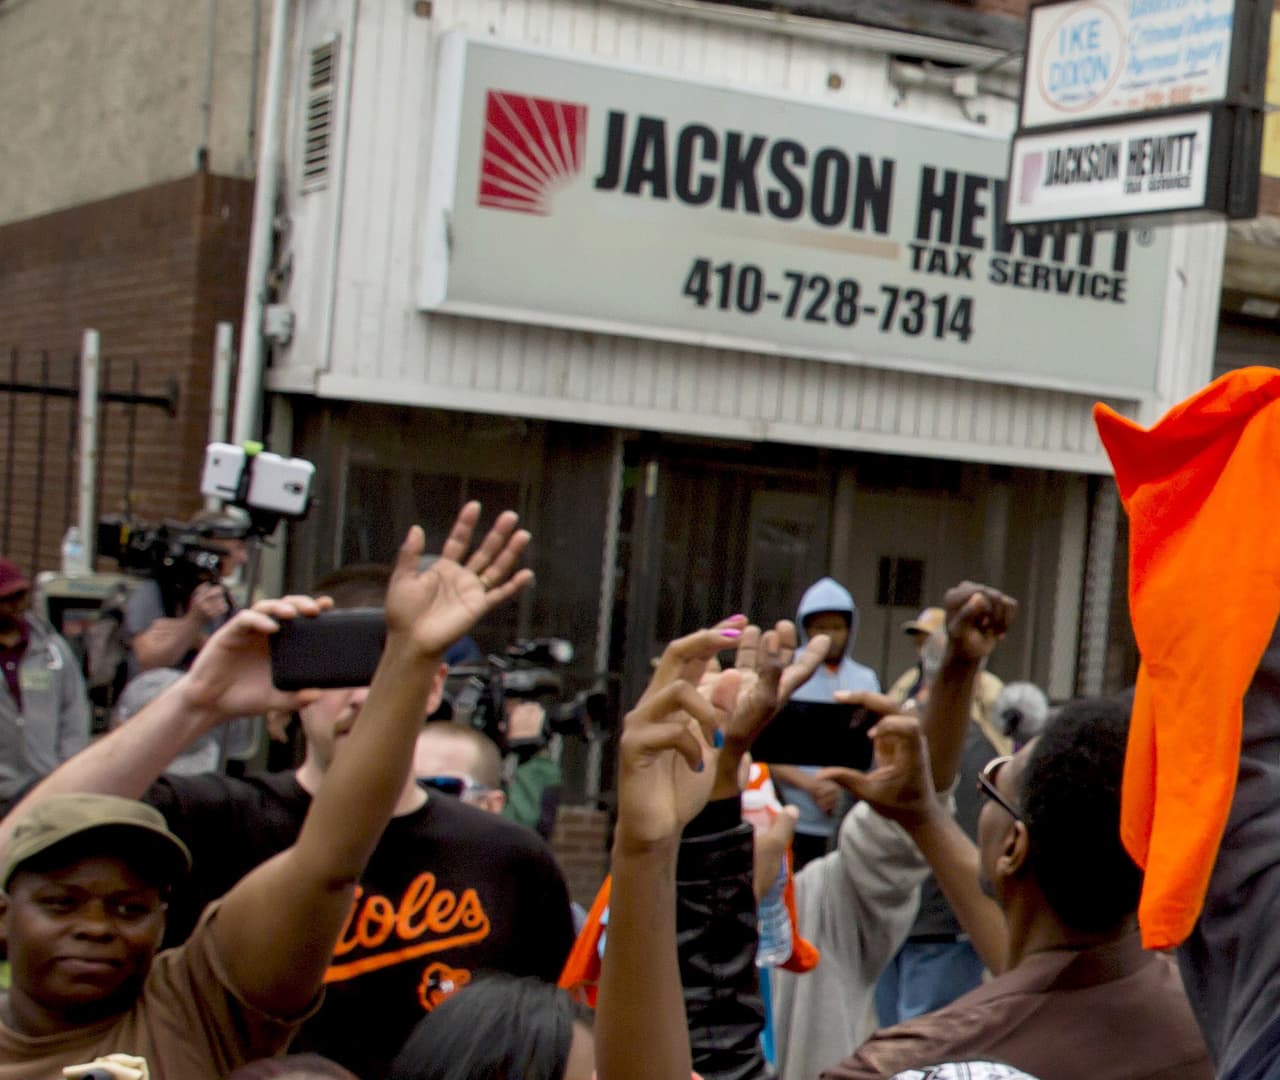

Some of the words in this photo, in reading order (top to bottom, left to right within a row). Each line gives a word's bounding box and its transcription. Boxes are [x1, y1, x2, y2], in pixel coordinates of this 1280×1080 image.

[1058, 18, 1102, 55] IKE
[1048, 52, 1111, 91] DIXON
[594, 109, 896, 236] JACKSON
[1043, 139, 1122, 187] JACKSON
[1126, 131, 1198, 177] HEWITT
[682, 256, 974, 342] 410-728-7314
[909, 243, 973, 281] TAX
[988, 257, 1127, 304] SERVICE
